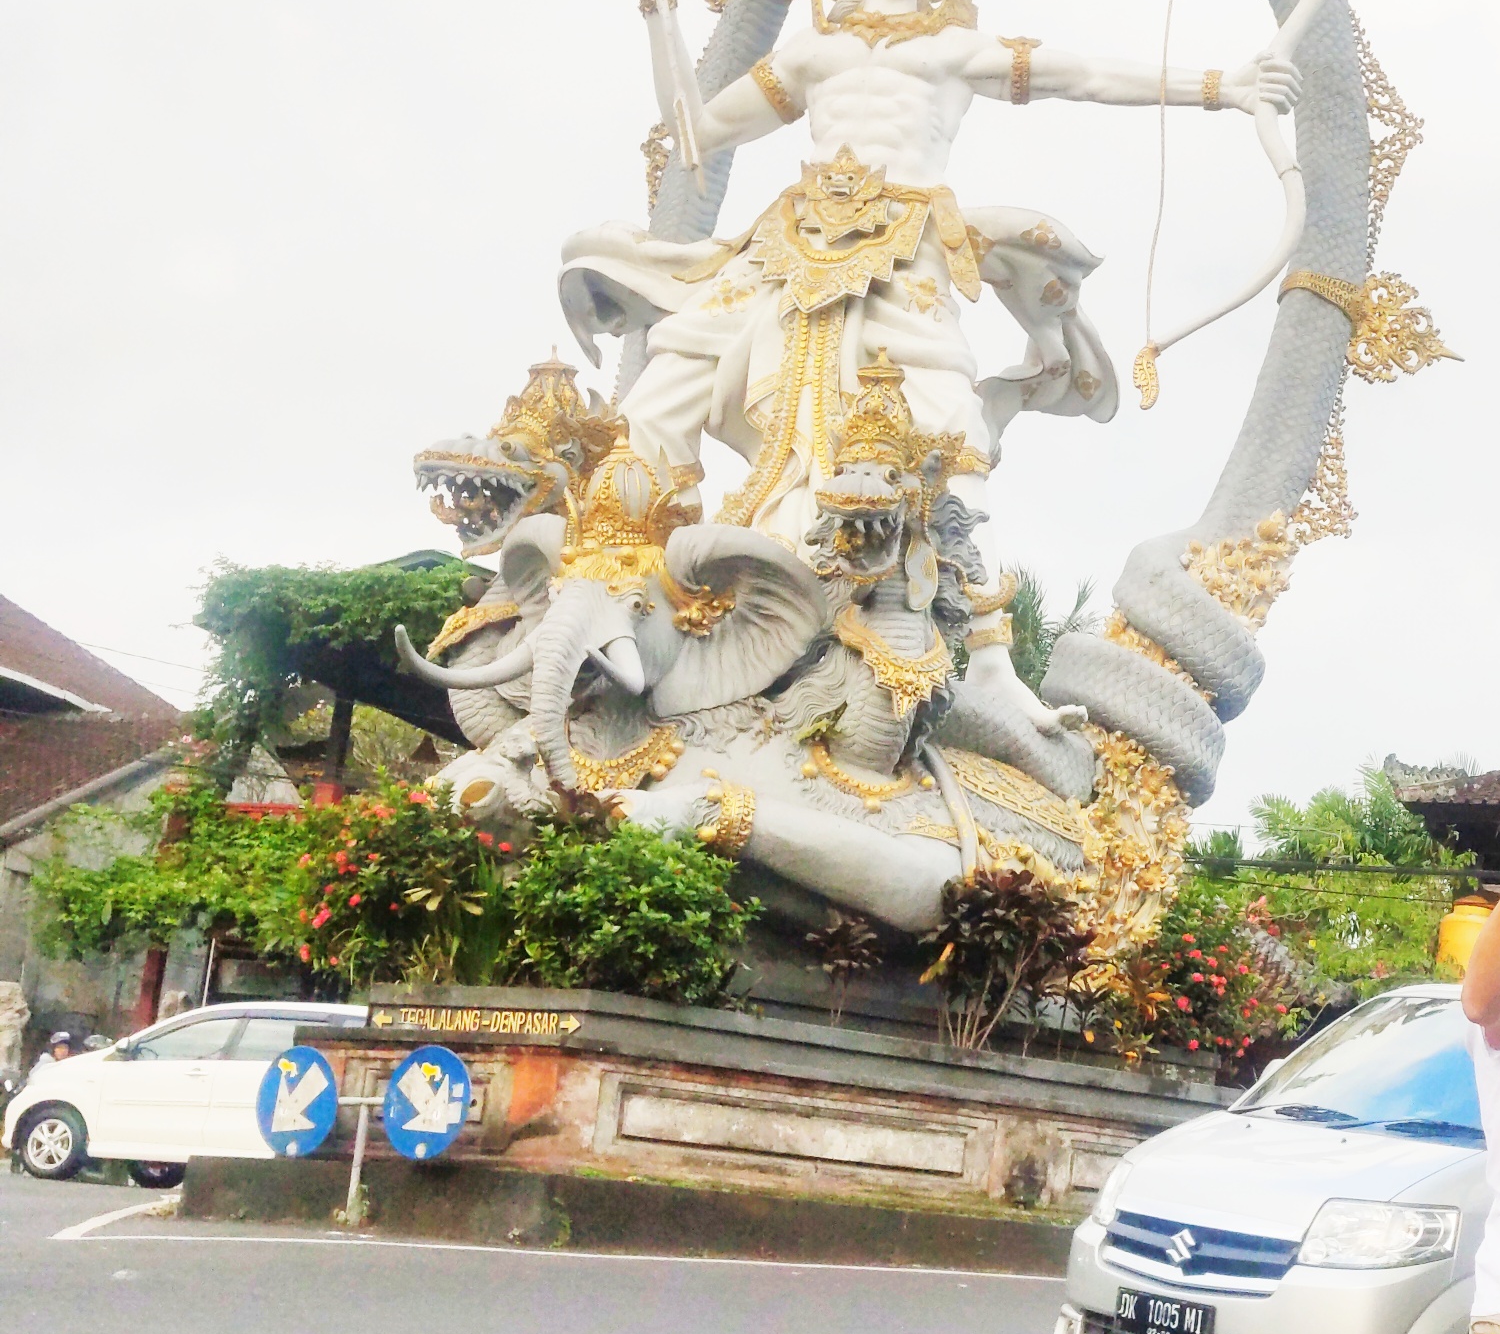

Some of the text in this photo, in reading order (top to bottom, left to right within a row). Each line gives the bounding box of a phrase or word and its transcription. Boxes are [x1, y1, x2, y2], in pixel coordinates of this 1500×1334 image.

[1118, 1293, 1203, 1334] DK 1005 MI
